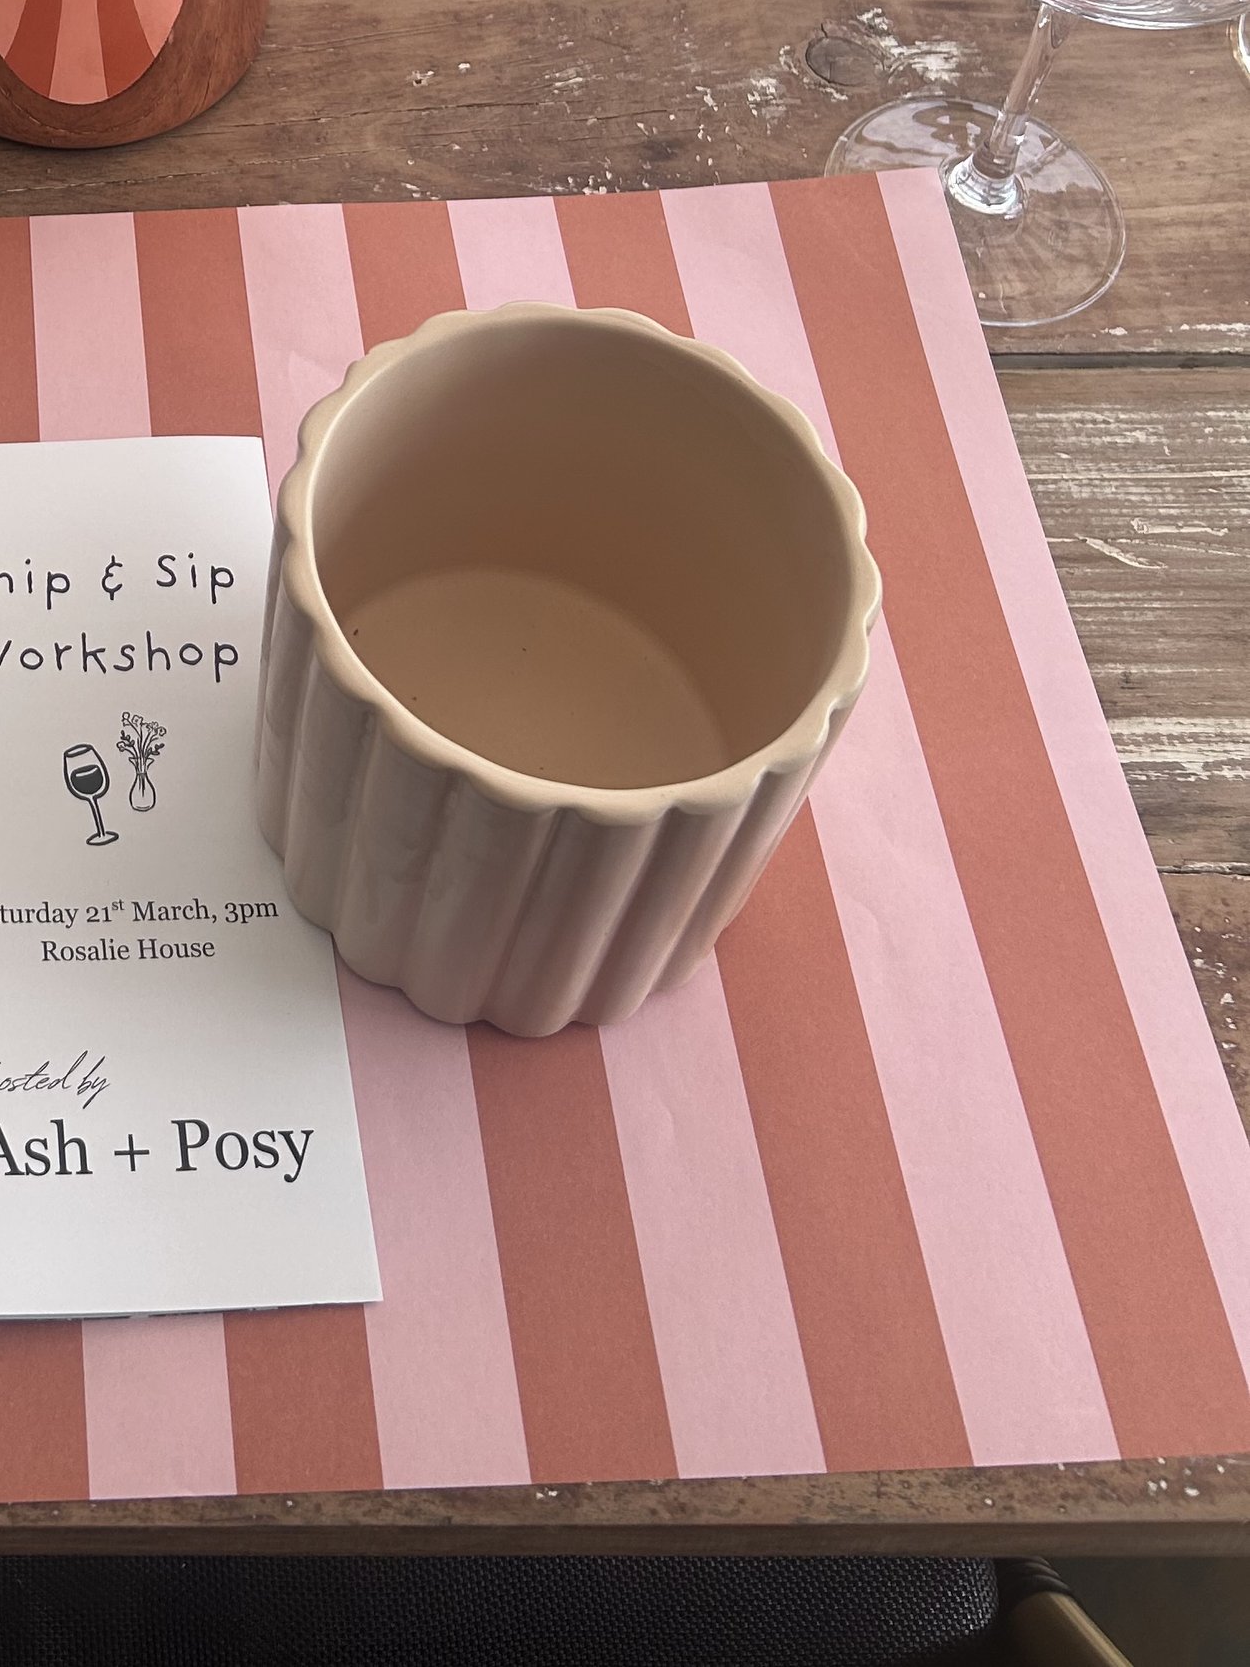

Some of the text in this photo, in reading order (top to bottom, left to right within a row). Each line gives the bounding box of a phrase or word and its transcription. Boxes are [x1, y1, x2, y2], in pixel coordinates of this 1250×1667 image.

[101, 554, 123, 601] &
[156, 551, 235, 604] Sip
[132, 898, 218, 925] March,
[224, 900, 280, 925] 3pm
[41, 937, 216, 962] Rosalie House
[76, 1055, 111, 1110] by
[113, 1133, 151, 1173] +
[170, 1118, 315, 1184] Posy
